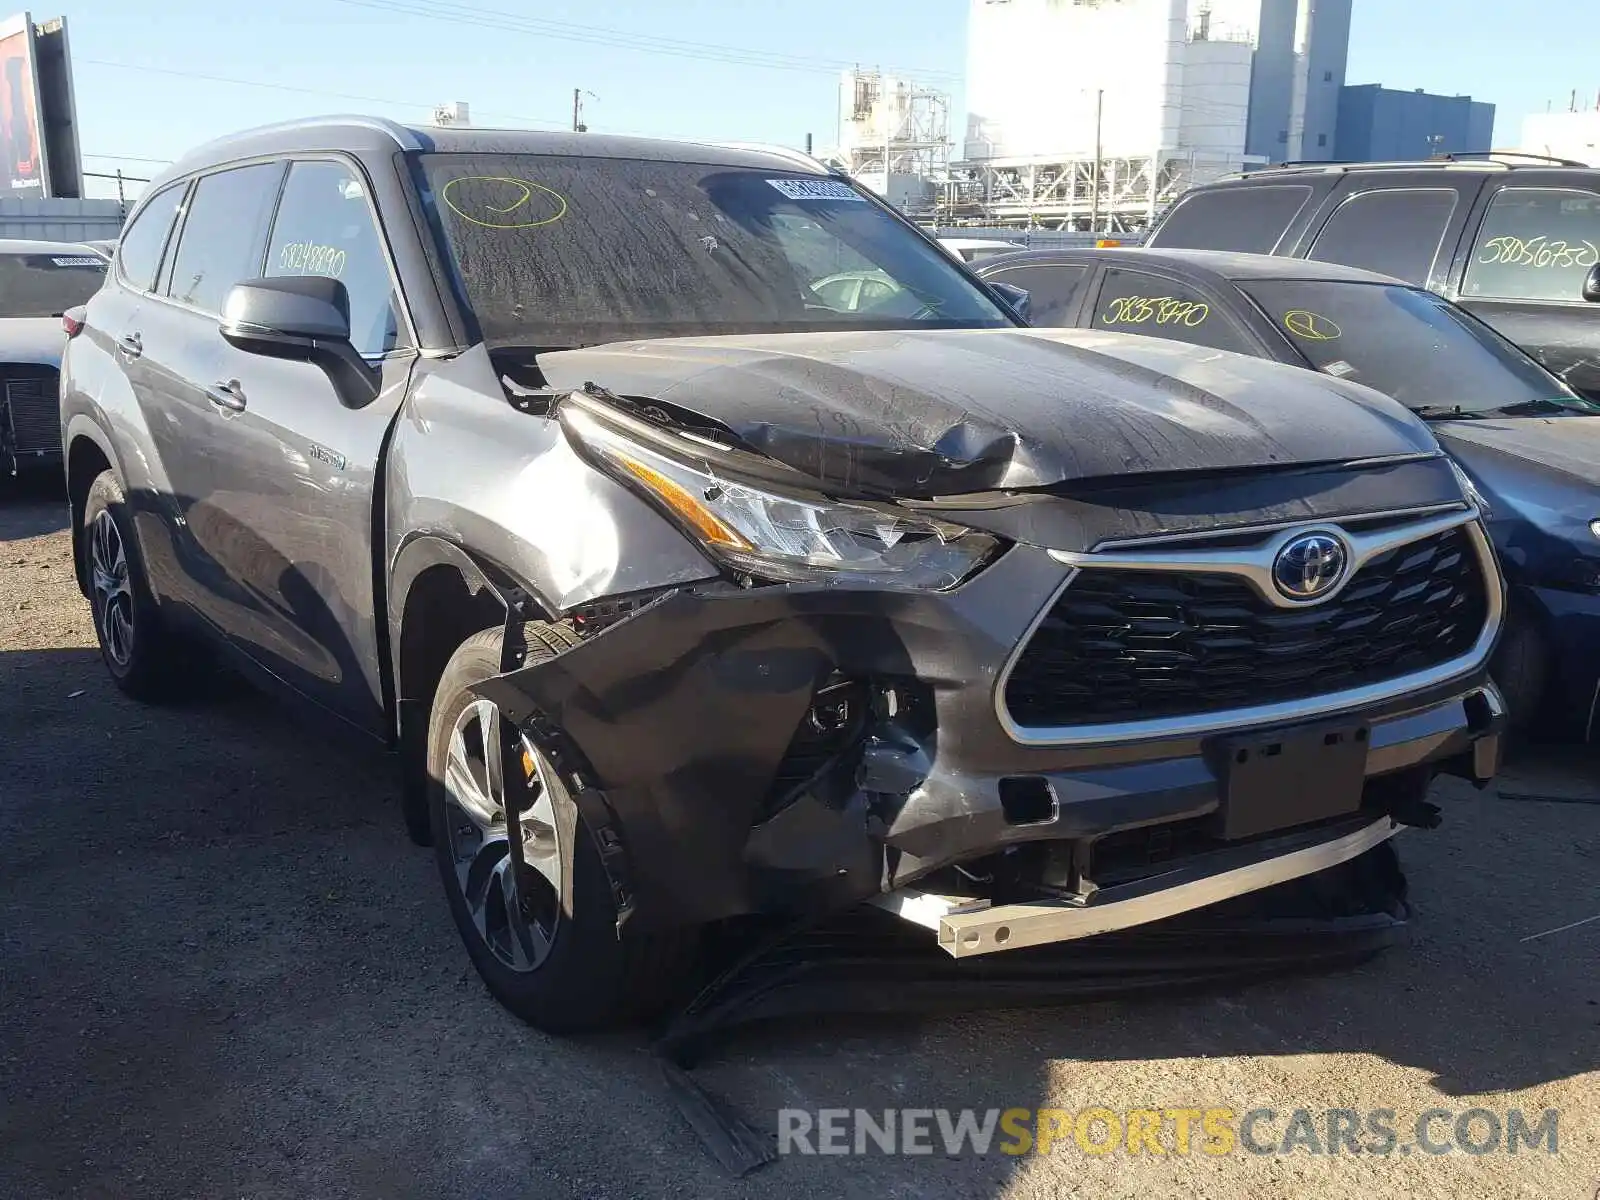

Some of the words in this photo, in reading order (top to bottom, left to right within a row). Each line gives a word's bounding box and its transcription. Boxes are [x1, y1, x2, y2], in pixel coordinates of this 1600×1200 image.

[280, 240, 345, 278] 58248890
[1480, 235, 1599, 268] 58056750
[1102, 295, 1209, 327] 58358770
